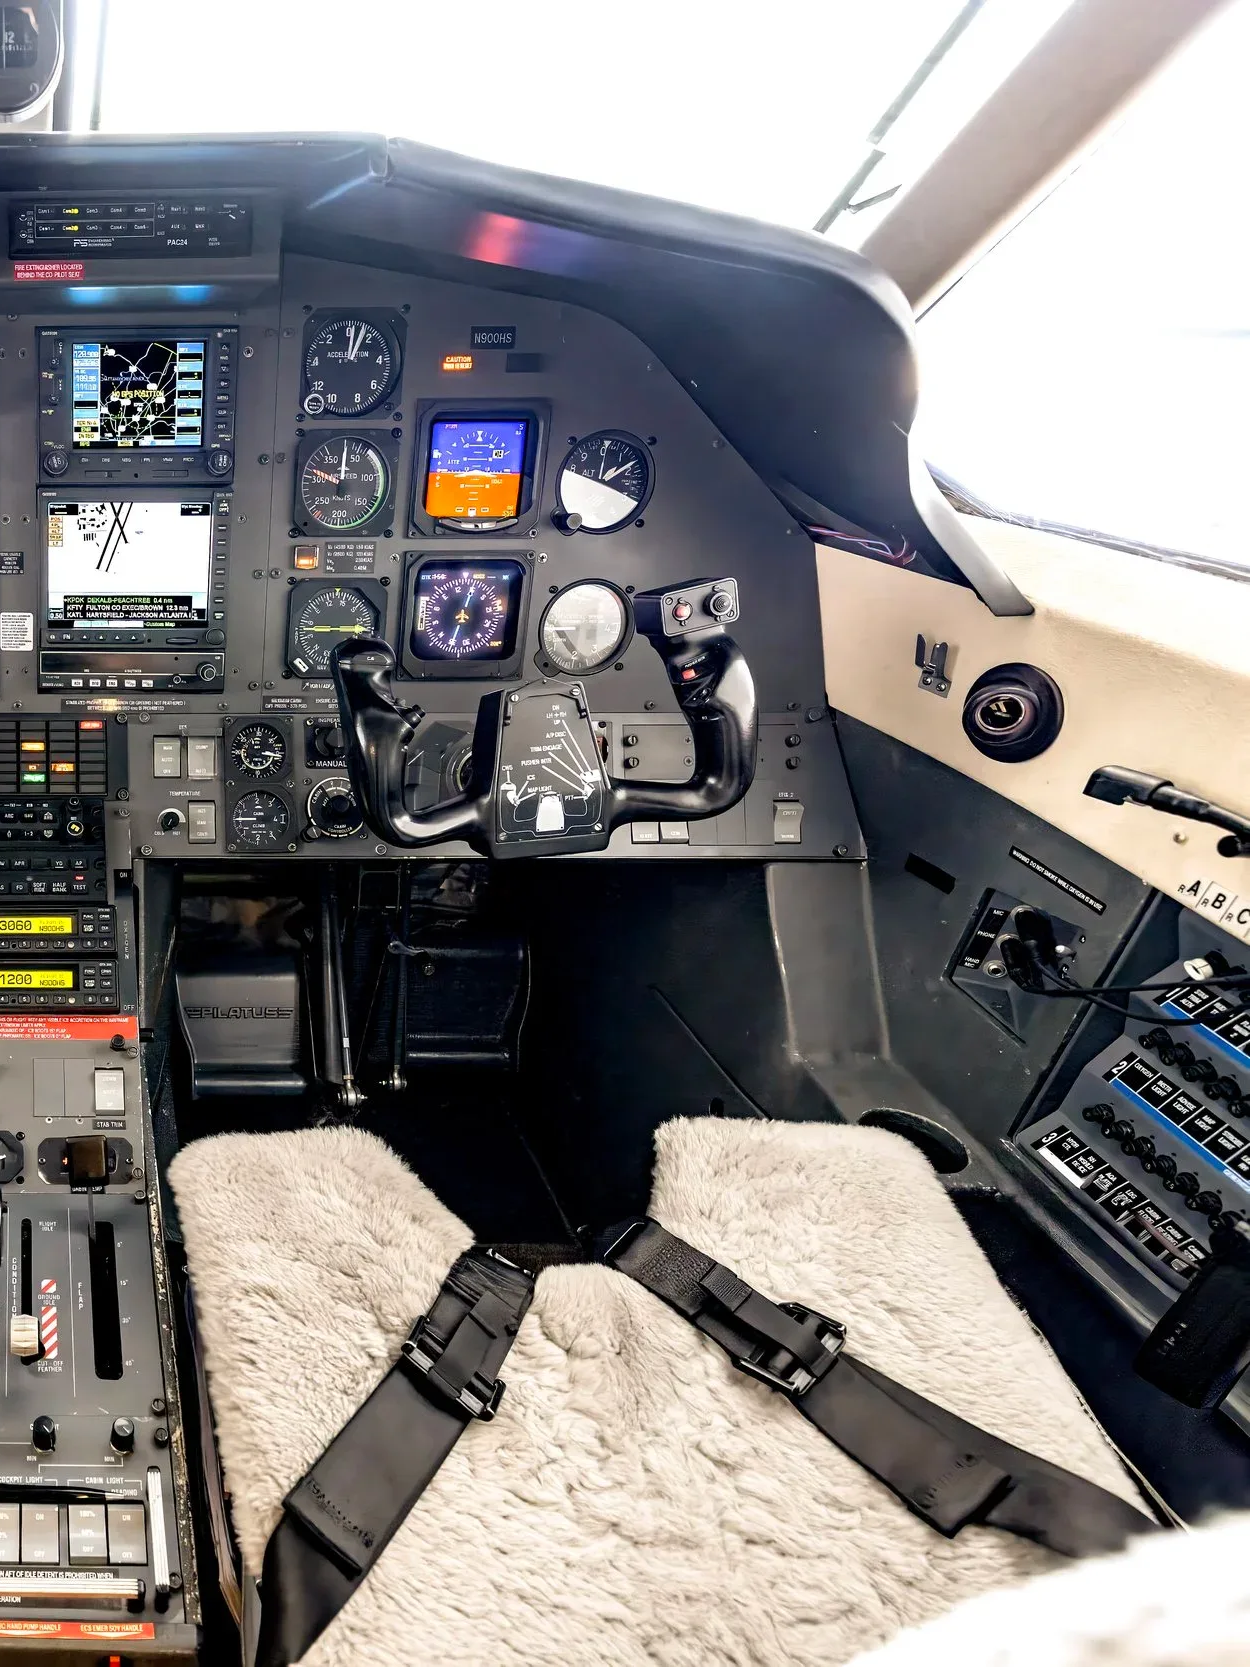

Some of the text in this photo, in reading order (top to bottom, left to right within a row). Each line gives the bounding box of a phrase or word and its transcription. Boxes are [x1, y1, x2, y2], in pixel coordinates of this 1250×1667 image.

[366, 334, 372, 343] 2
[474, 333, 512, 344] N900HS
[376, 356, 383, 365] 4
[314, 382, 324, 391] 12
[371, 380, 377, 390] 6
[121, 391, 134, 399] GPS
[134, 390, 165, 398] POSITION
[326, 394, 337, 404] 10
[355, 393, 361, 403] 8
[324, 456, 339, 464] 350
[350, 456, 360, 464] 50
[581, 452, 588, 462] 9
[361, 474, 374, 482] 100
[315, 496, 330, 505] 250
[355, 497, 368, 506] 150
[332, 510, 347, 518] 200
[1178, 884, 1186, 893] R
[1187, 880, 1201, 896] A
[1201, 898, 1210, 908] R
[1211, 893, 1227, 910] B
[1225, 913, 1234, 922] R
[1237, 909, 1250, 924] C
[0, 920, 32, 931] 3060
[977, 930, 996, 939] PHONE
[964, 956, 980, 964] HAND
[0, 974, 32, 985] 1200
[202, 1007, 279, 1019] PILATUS
[1111, 1060, 1128, 1074] 2
[1134, 1062, 1154, 1079] OXYGEN
[1151, 1085, 1168, 1097] LIGHT
[1156, 1080, 1173, 1092] INSTR
[1173, 1102, 1190, 1115] LIGHT
[1177, 1096, 1197, 1111] ADVISE
[1202, 1115, 1216, 1125] MAP
[1194, 1119, 1212, 1132] LIGHT
[1042, 1132, 1058, 1144] 3
[1218, 1137, 1237, 1151] LIGHT
[1145, 1207, 1161, 1221] CABIN
[1166, 1225, 1184, 1240] CABIN
[81, 1624, 91, 1632] ECS
